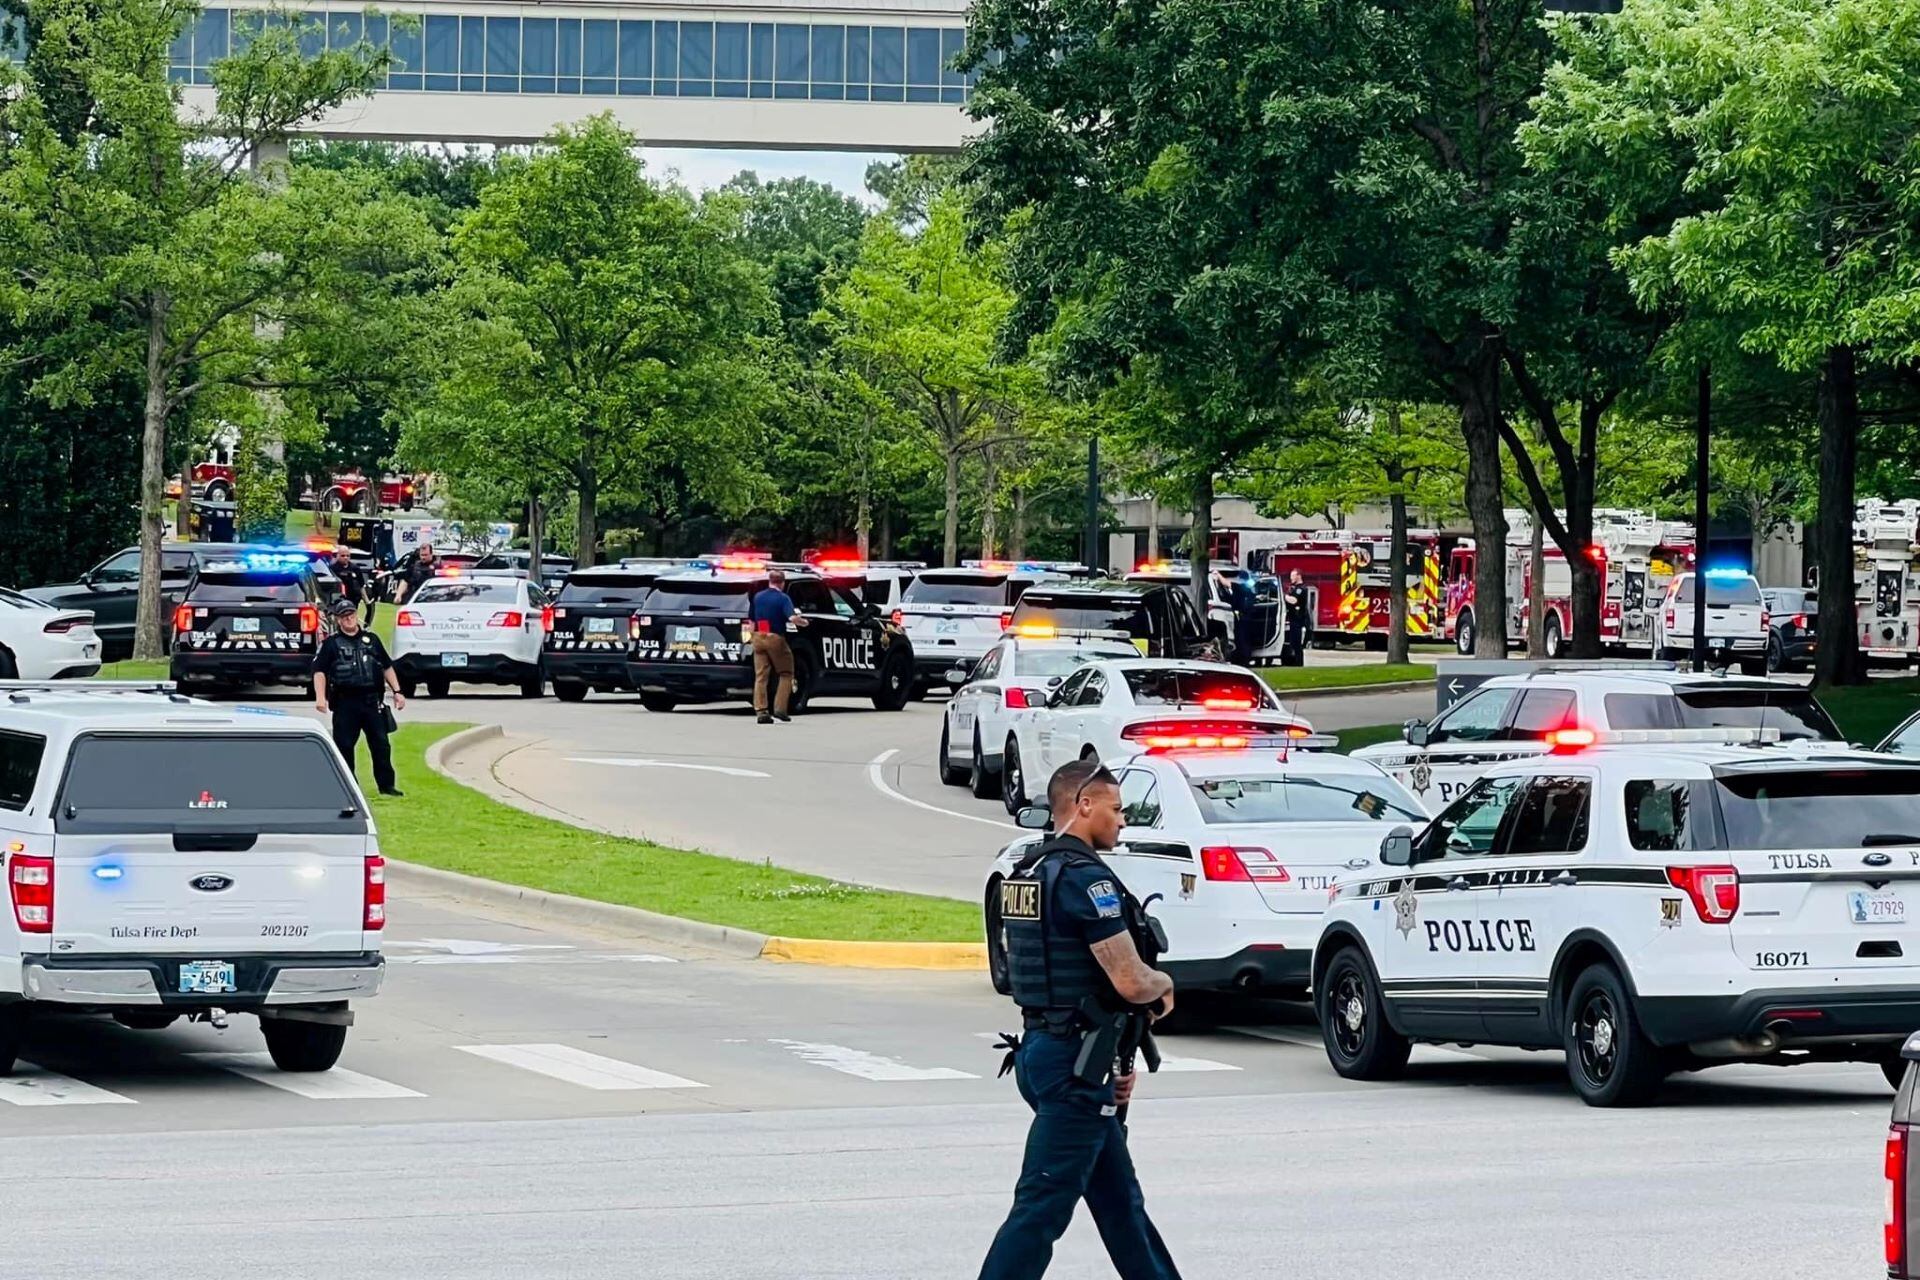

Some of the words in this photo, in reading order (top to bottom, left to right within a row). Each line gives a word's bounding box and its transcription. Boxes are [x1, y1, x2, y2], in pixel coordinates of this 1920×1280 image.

[191, 631, 216, 640] TULSA
[274, 632, 301, 640] POLICE
[554, 631, 574, 639] TULSA
[639, 640, 659, 649] TULSA
[713, 642, 741, 651] POLICE
[822, 637, 876, 670] POLICE
[189, 800, 229, 809] LEER
[1768, 853, 1832, 870] TULSA
[1002, 885, 1036, 916] POLICE
[1871, 901, 1905, 916] 27929
[110, 926, 140, 938] Tulsa
[144, 926, 167, 938] Fire
[260, 924, 309, 937] 2021207
[1423, 919, 1537, 952] POLICE
[1755, 951, 1810, 967] 16071
[199, 970, 233, 985] 45491
